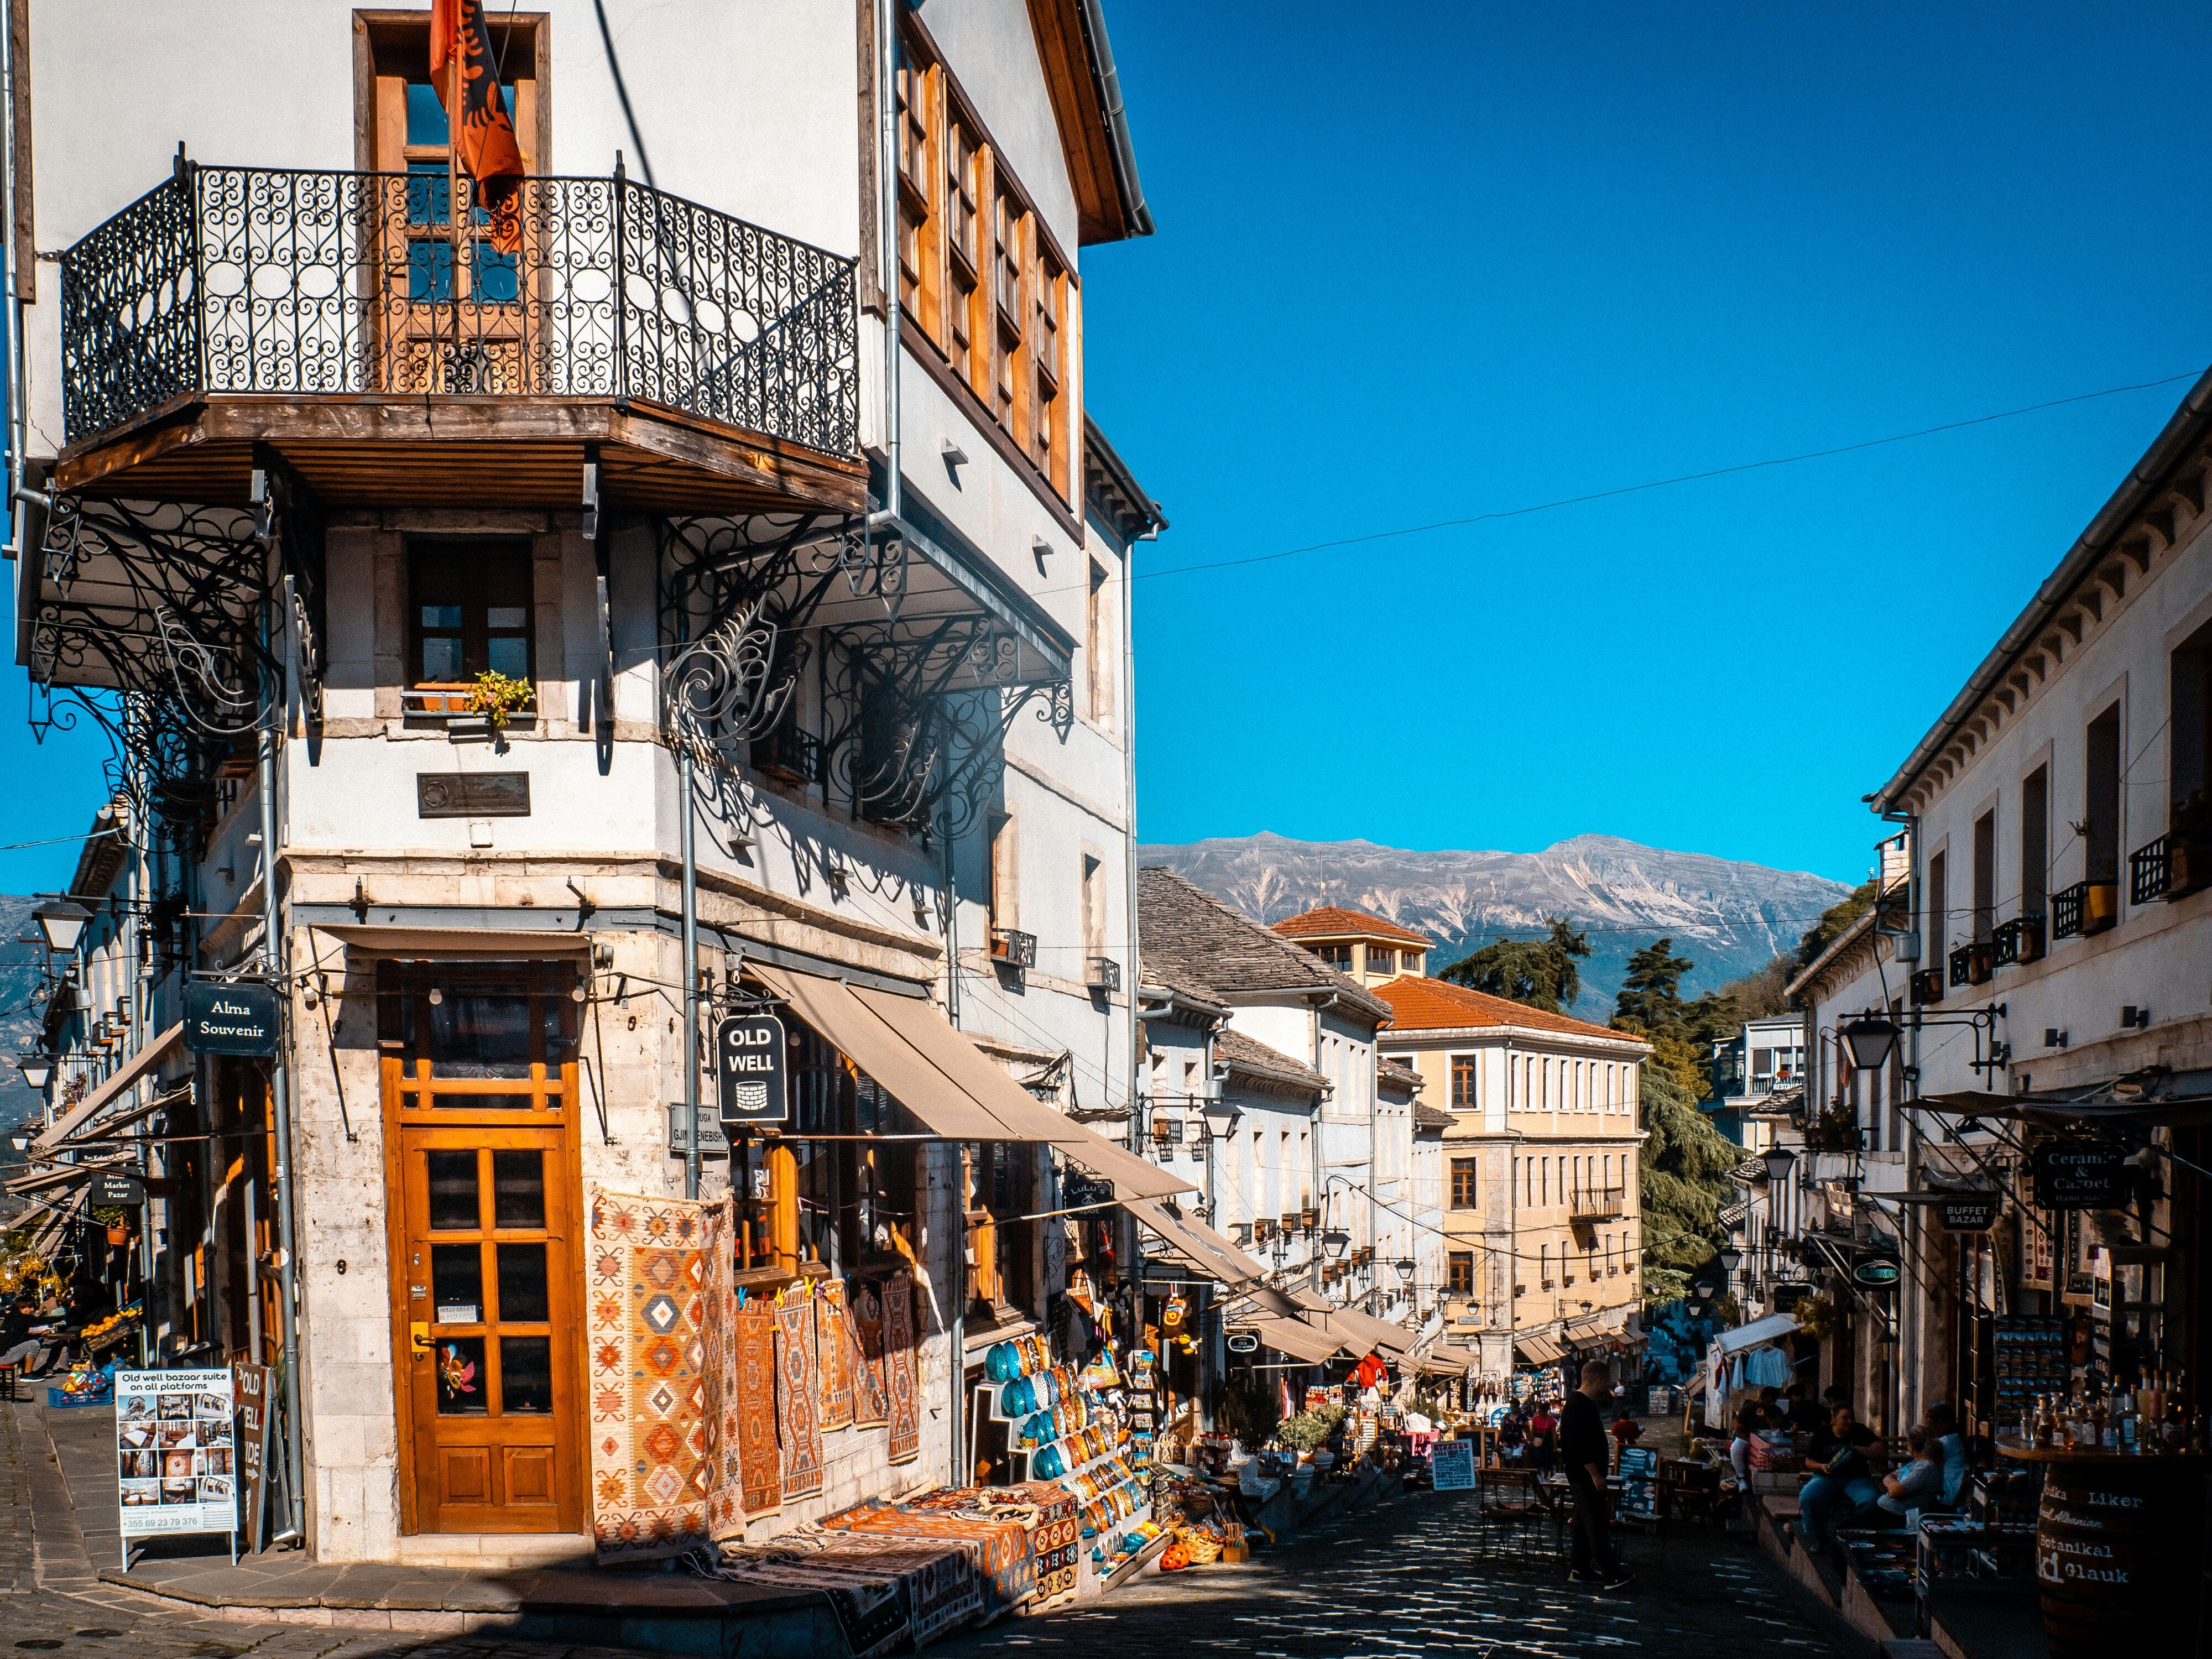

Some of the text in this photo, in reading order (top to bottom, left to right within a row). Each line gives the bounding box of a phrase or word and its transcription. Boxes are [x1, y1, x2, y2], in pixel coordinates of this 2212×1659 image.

[211, 1001, 251, 1015] Alma
[201, 1021, 264, 1037] Souvenir
[729, 1029, 771, 1046] OLD
[729, 1055, 774, 1072] WELL
[2075, 1166, 2089, 1177] &
[1071, 1184, 1105, 1194] LuLu's
[2053, 1177, 2110, 1190] Carpet
[1947, 1206, 1989, 1215] BUFFET
[1949, 1215, 1984, 1224] BAZAR
[122, 1374, 140, 1382] Old
[242, 1371, 260, 1396] OLD
[160, 1382, 207, 1392] platforms
[245, 1441, 260, 1466] IDE
[2044, 1485, 2067, 1501] odka
[2088, 1492, 2143, 1507] Liker
[2041, 1534, 2114, 1558] Botanikal
[2065, 1562, 2129, 1583] Glauk
